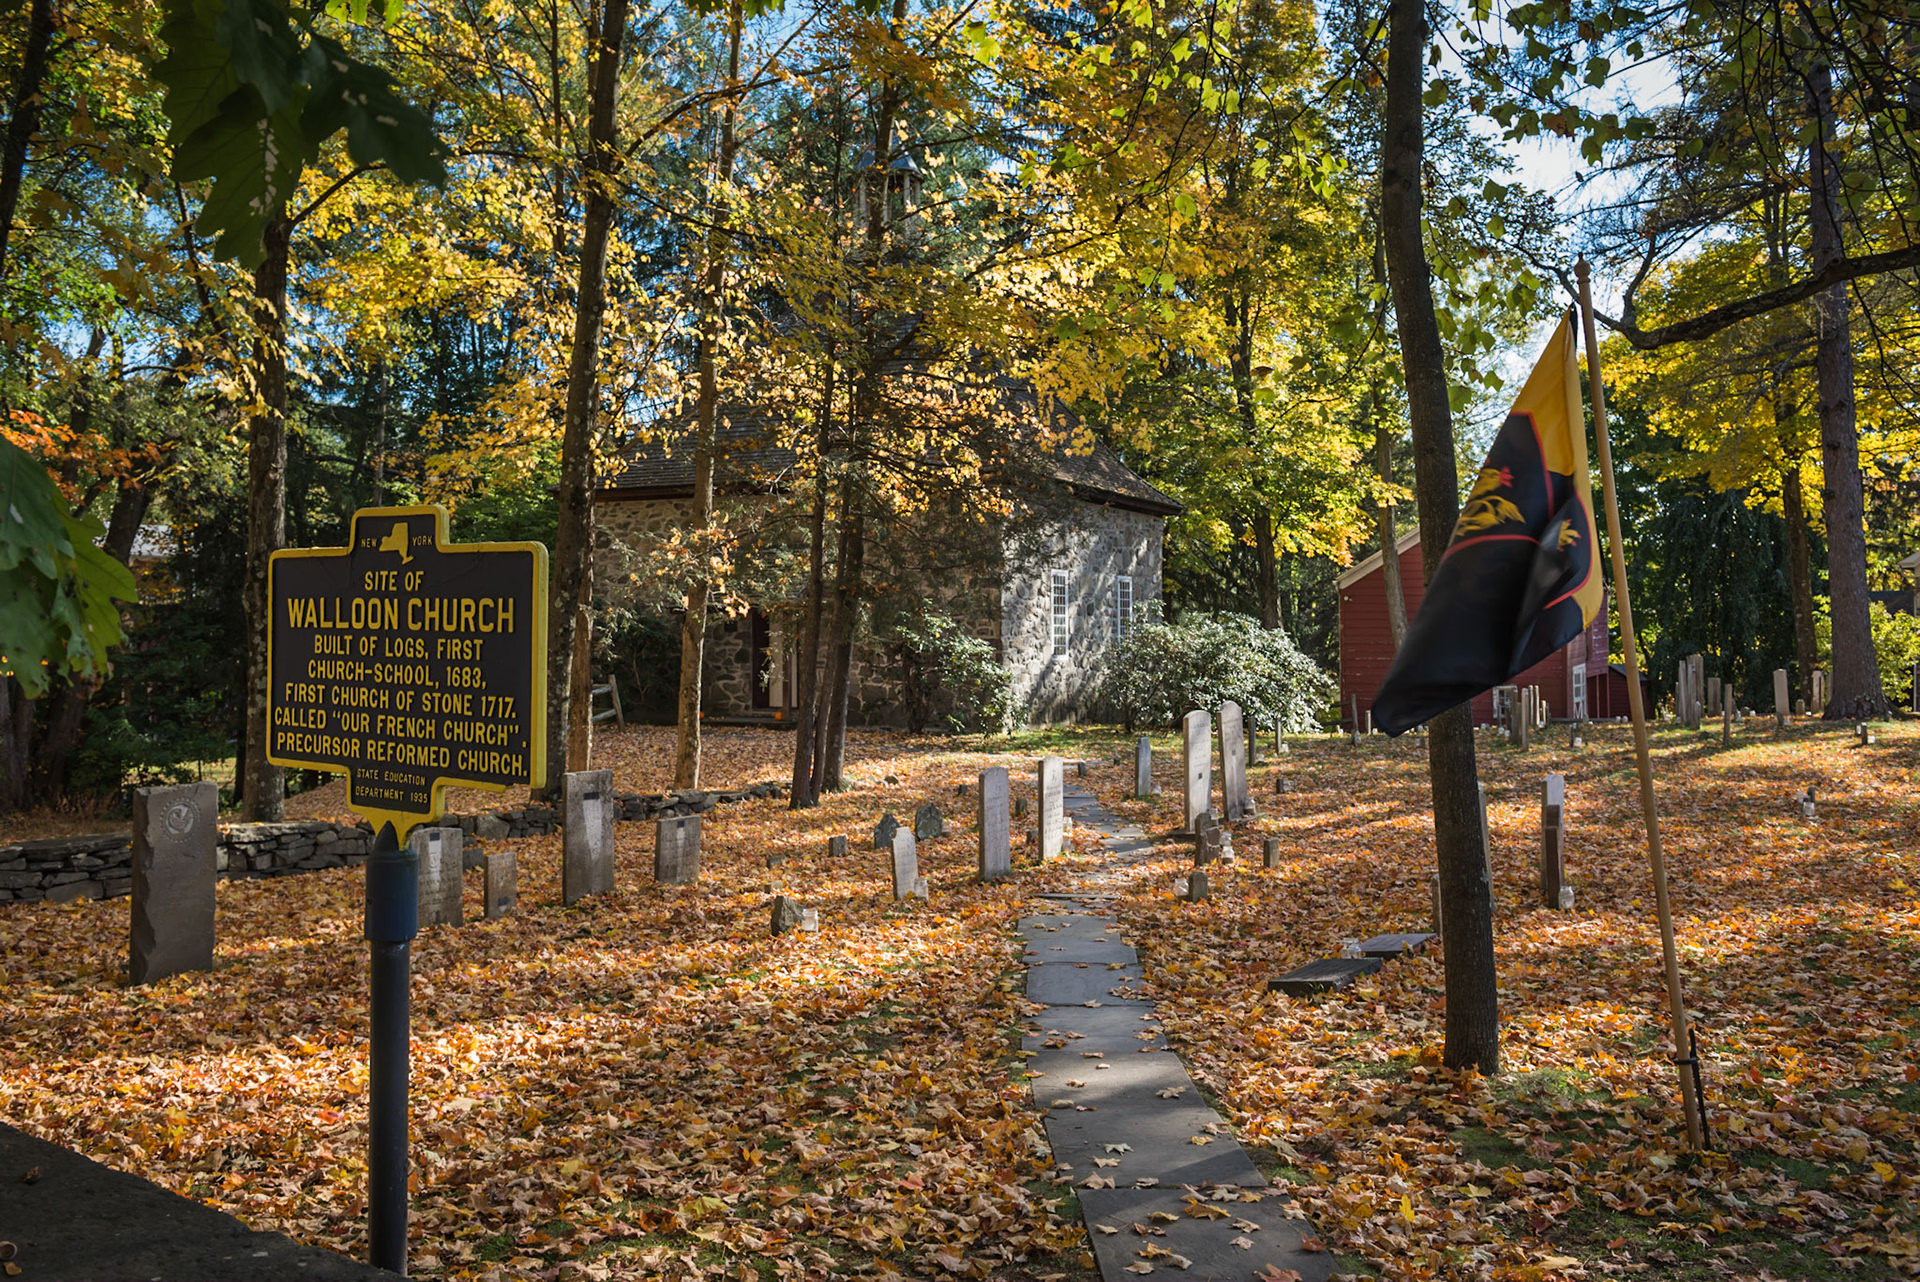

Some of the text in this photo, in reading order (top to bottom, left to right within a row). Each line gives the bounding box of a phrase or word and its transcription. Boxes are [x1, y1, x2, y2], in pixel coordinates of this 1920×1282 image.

[361, 535, 433, 548] NEW YORK
[364, 571, 424, 591] SITE OF
[287, 597, 514, 633] WALLOON CHURCH
[314, 634, 483, 660] BUILT OF LOGS, FIRST
[308, 660, 487, 689] CHURCH-SCHOOL, 1683,
[285, 682, 517, 719] FIRST CHURCH OF STONE 1717.
[274, 707, 326, 730] CALLED
[377, 714, 435, 740] FRENCH
[277, 732, 528, 777] PRECURSOR REFORMED CHURCH.
[356, 768, 426, 786] STATE EDUCATION
[355, 787, 428, 803] DEPARTMENT 1935
